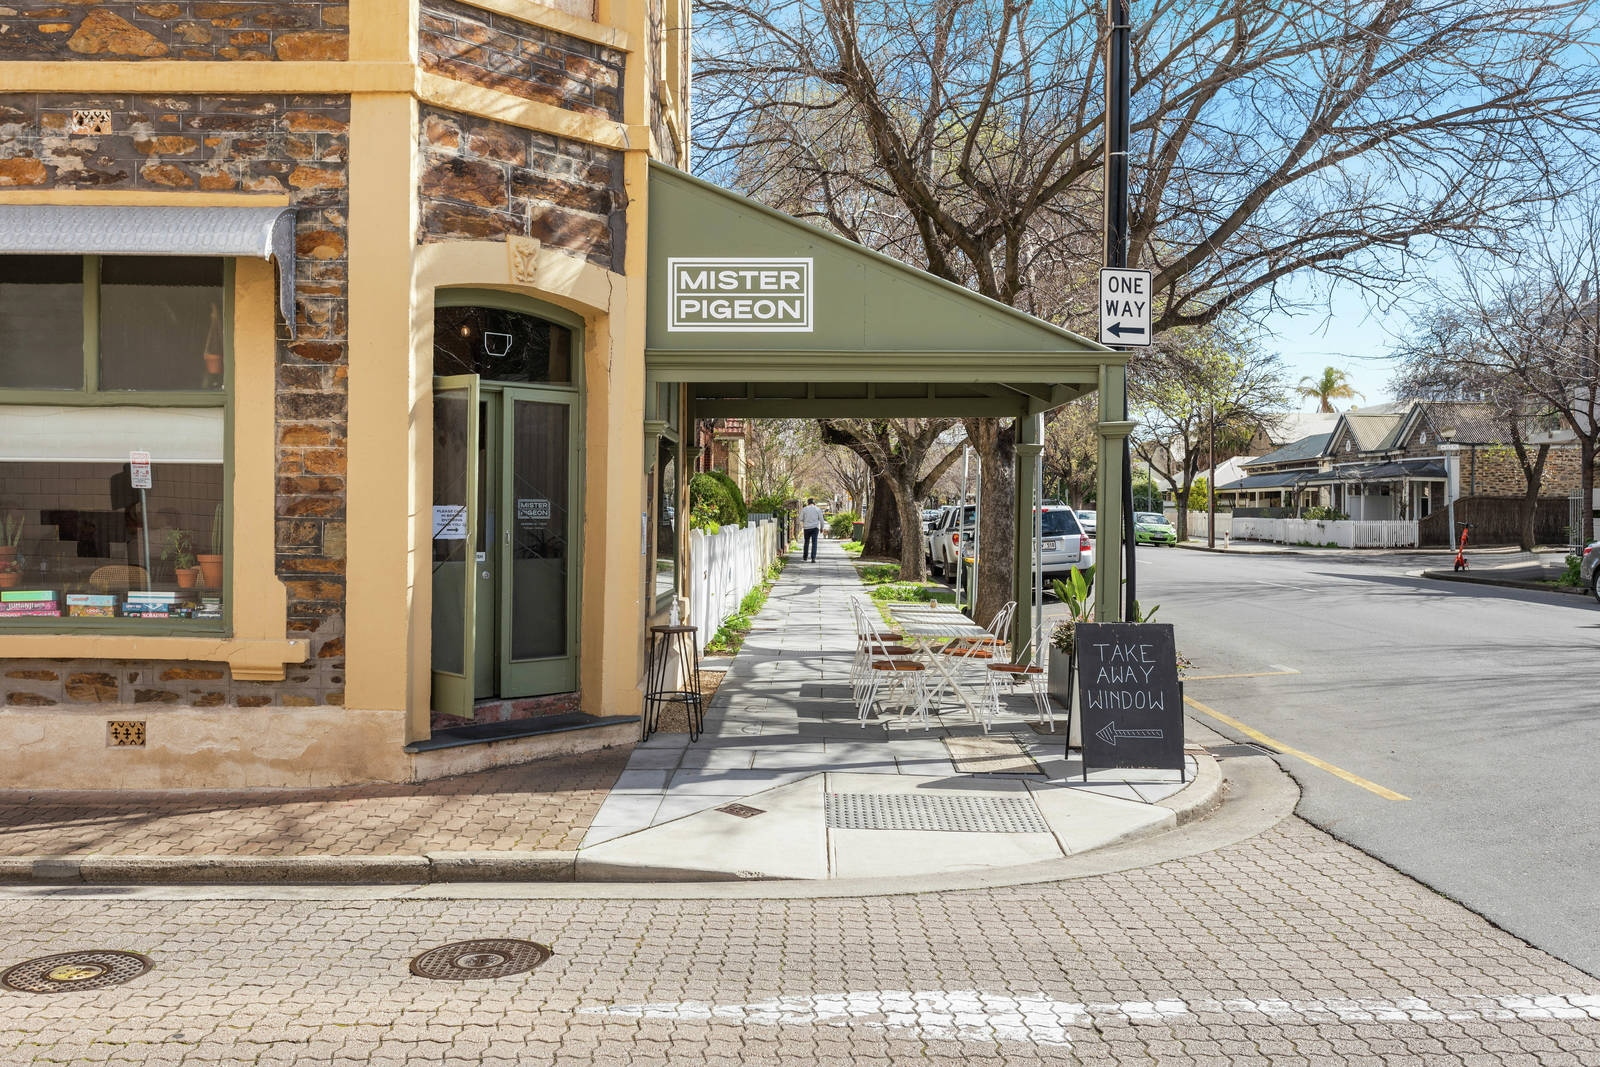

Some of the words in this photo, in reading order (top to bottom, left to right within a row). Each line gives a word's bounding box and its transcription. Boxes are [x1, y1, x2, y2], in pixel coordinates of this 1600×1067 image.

[680, 270, 800, 290] MISTER
[1108, 275, 1144, 294] ONE
[680, 299, 800, 319] PIGEON
[1105, 299, 1146, 318] WAY
[1092, 643, 1157, 663] TAKE
[1096, 665, 1154, 684] AWAY
[1087, 689, 1164, 711] WINDOW
